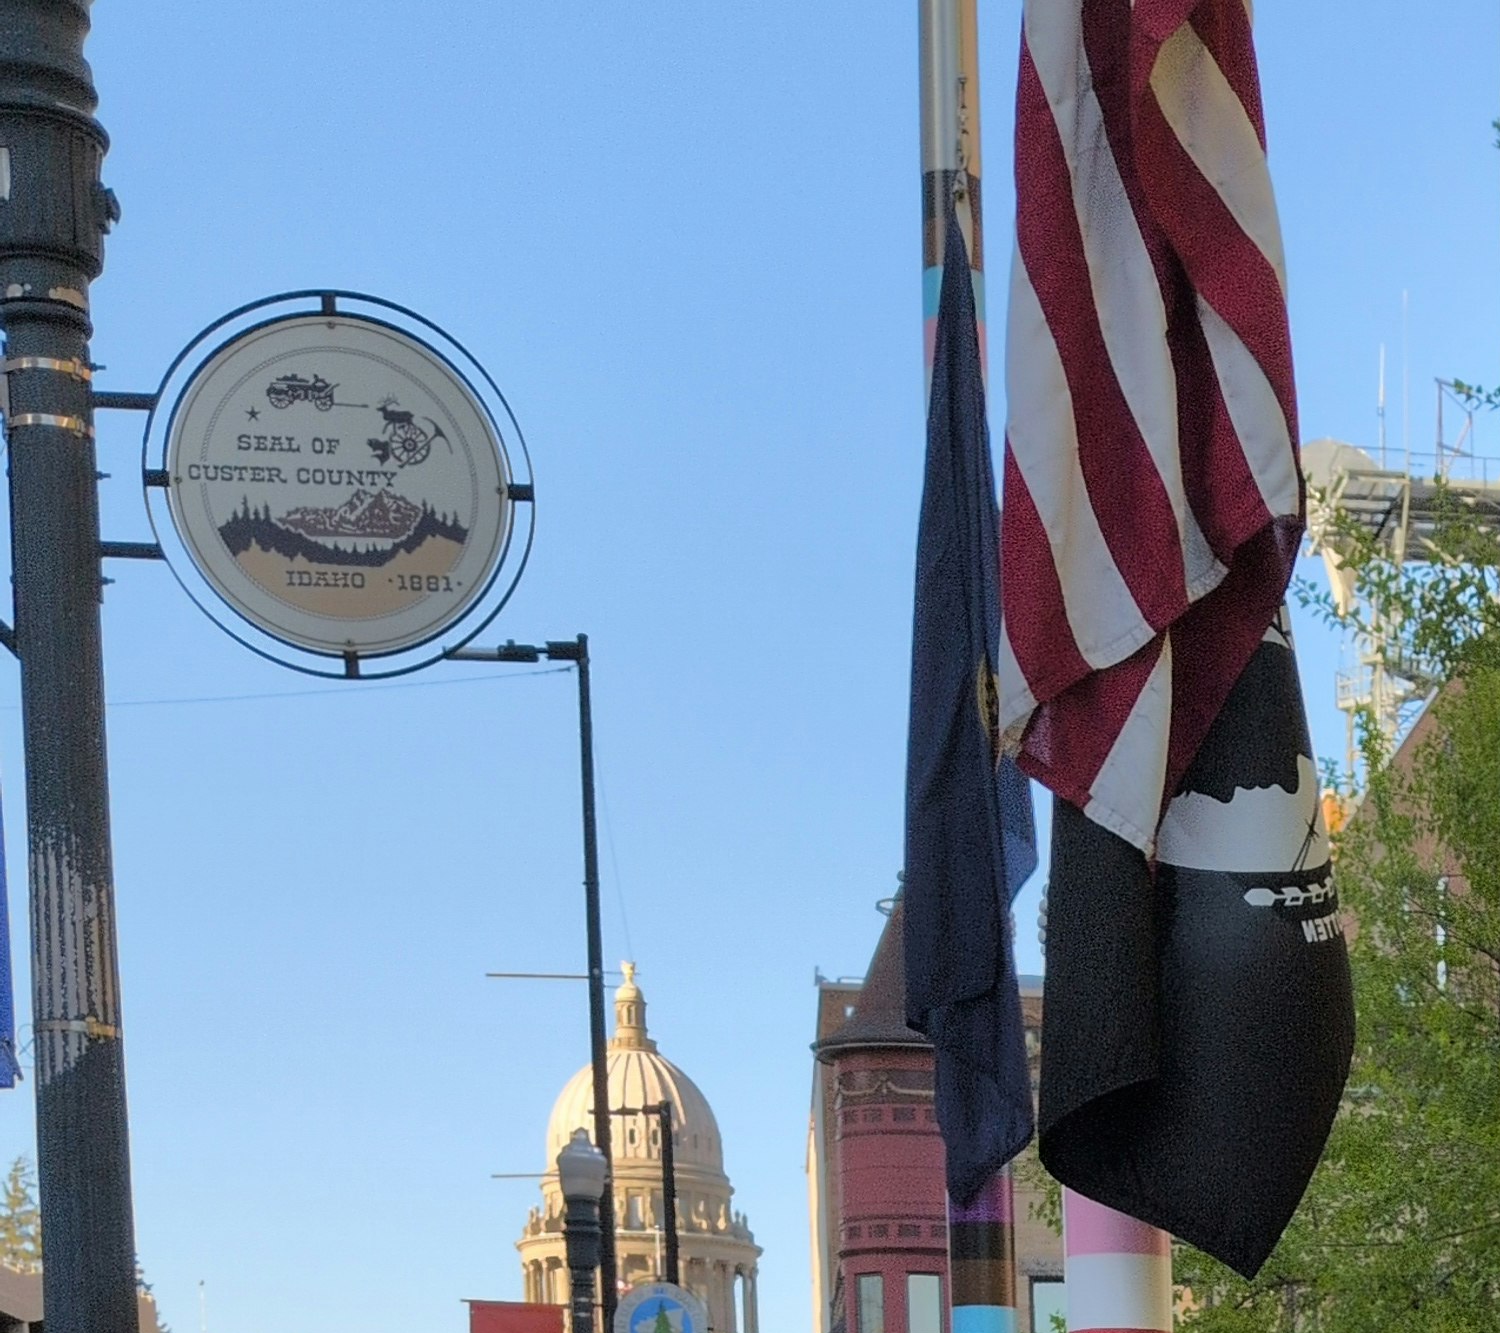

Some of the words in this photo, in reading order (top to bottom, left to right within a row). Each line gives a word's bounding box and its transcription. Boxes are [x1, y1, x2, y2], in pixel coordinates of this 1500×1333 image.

[236, 434, 301, 453] SEAL
[311, 438, 340, 455] OF
[187, 463, 287, 485] CUSTER
[296, 467, 397, 488] COUNTY
[285, 570, 366, 589] IDAHO
